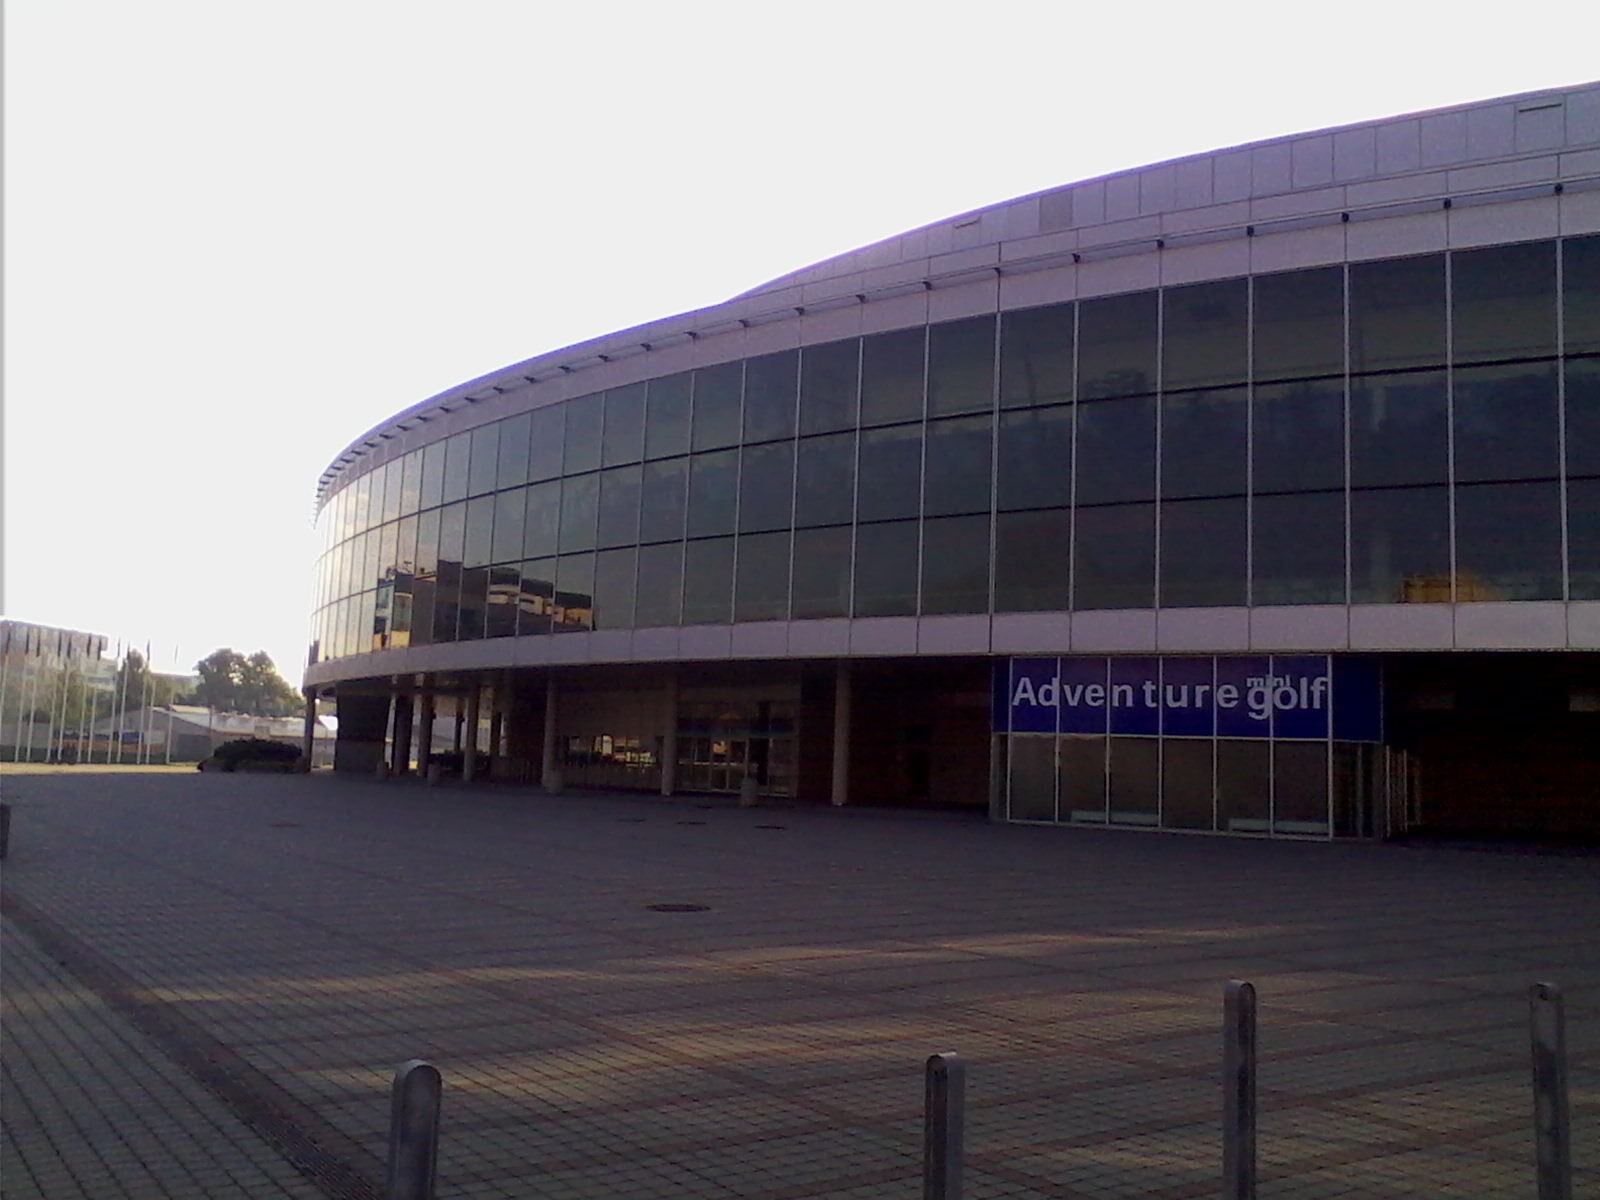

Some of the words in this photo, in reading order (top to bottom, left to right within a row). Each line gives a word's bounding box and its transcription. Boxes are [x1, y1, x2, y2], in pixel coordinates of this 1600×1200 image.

[1247, 675, 1290, 688] mini
[1012, 677, 1238, 708] Adventure
[1247, 677, 1327, 720] golf
